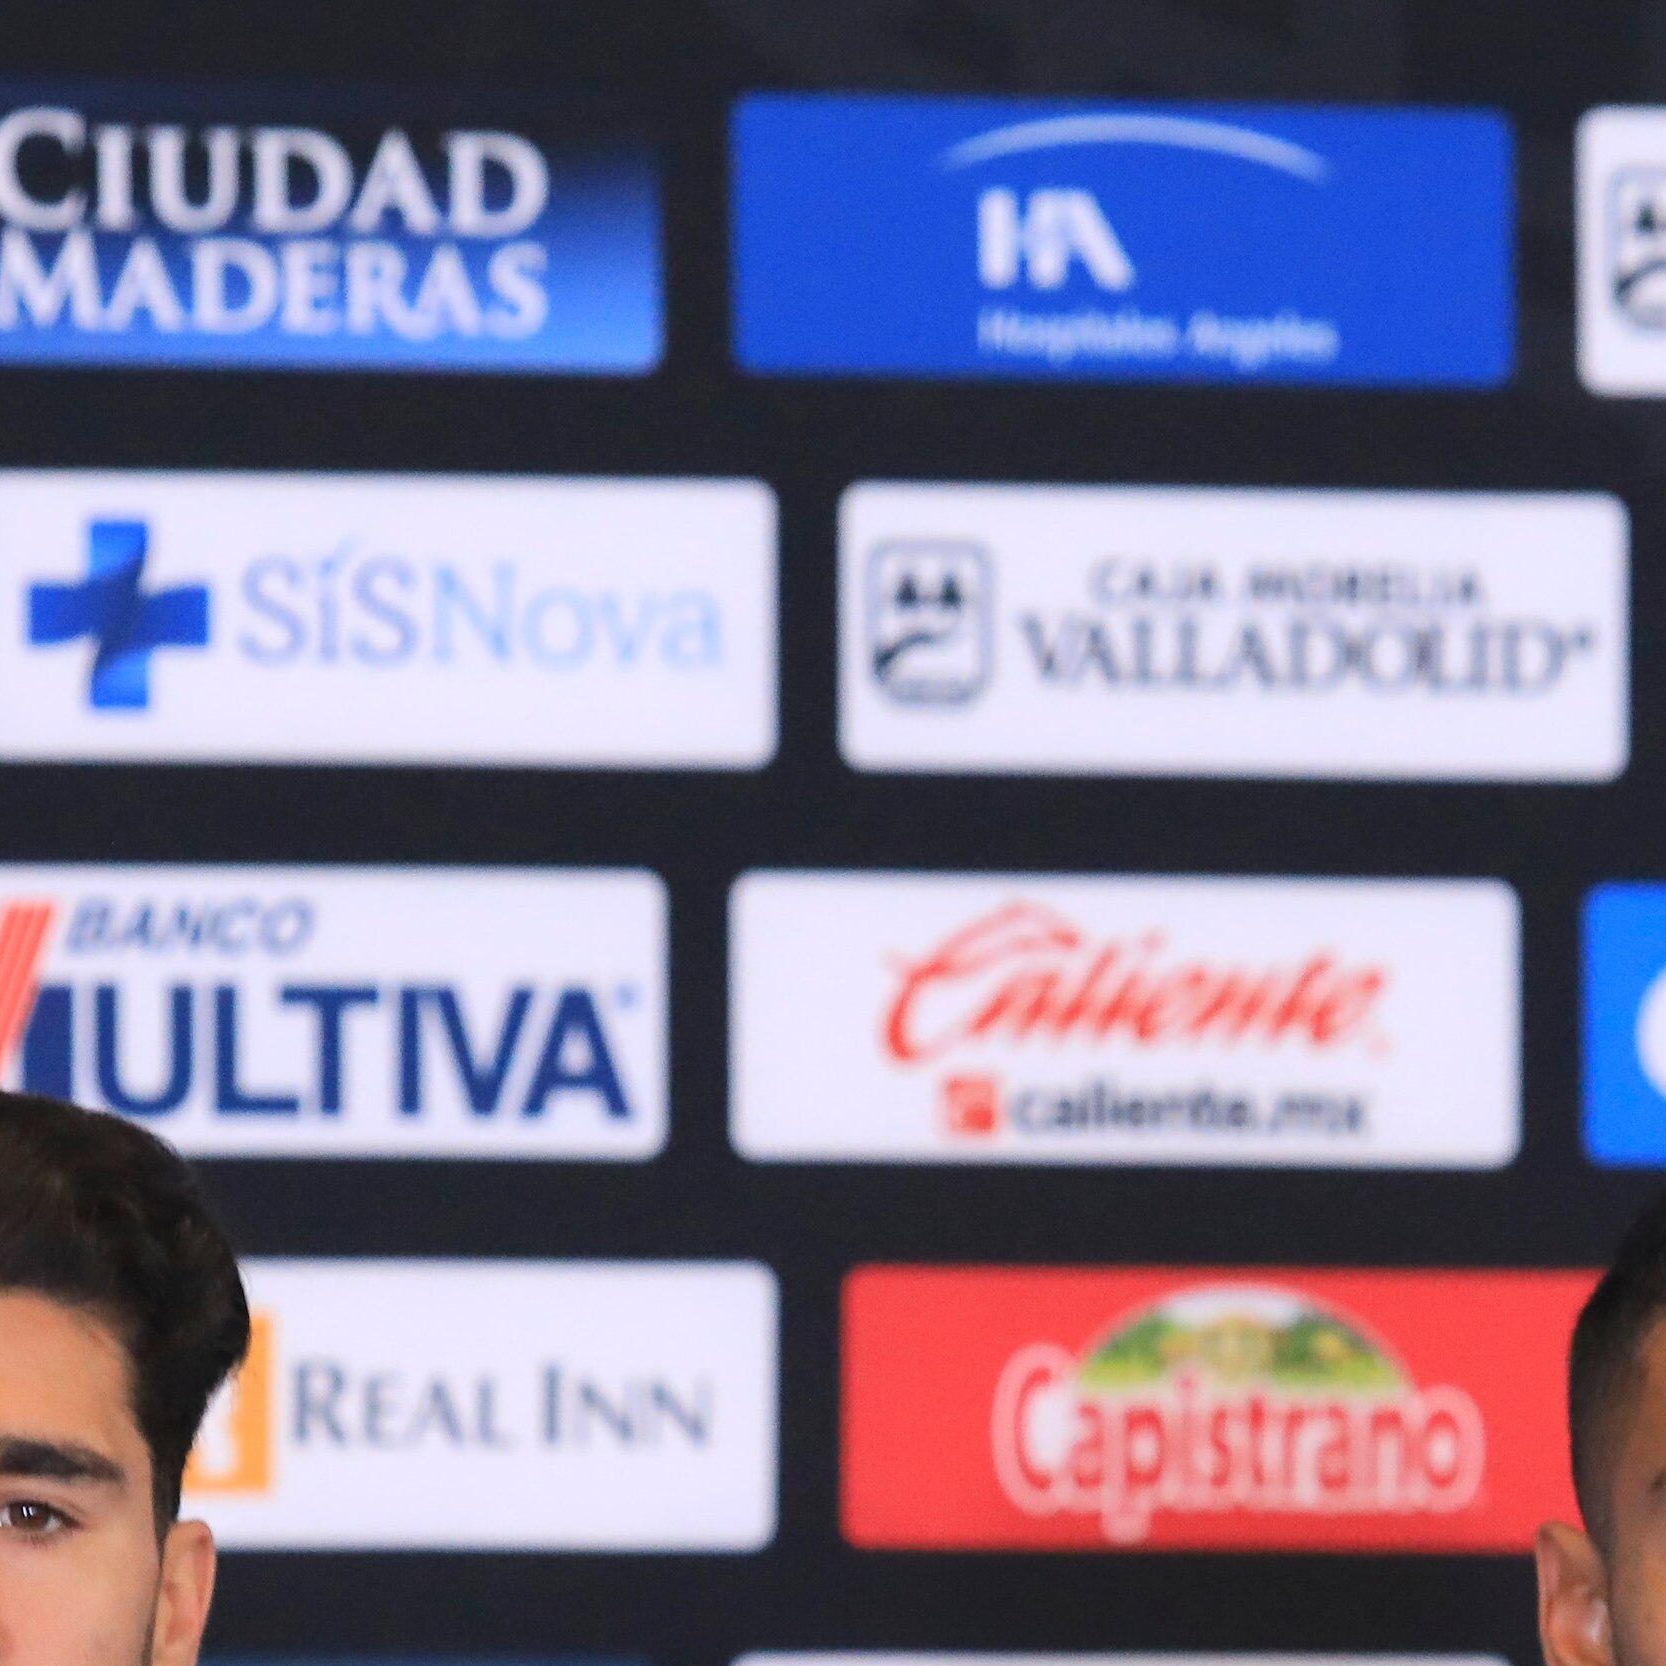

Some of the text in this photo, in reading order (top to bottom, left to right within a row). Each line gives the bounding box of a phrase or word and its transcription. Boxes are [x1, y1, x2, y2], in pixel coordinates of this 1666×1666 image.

[1020, 613, 1571, 695] VALLADOLID
[65, 900, 316, 953] BANCO
[879, 897, 1388, 1066] Caliente
[1013, 1076, 1369, 1137] caliente.mx
[991, 1344, 1485, 1545] Capistrano
